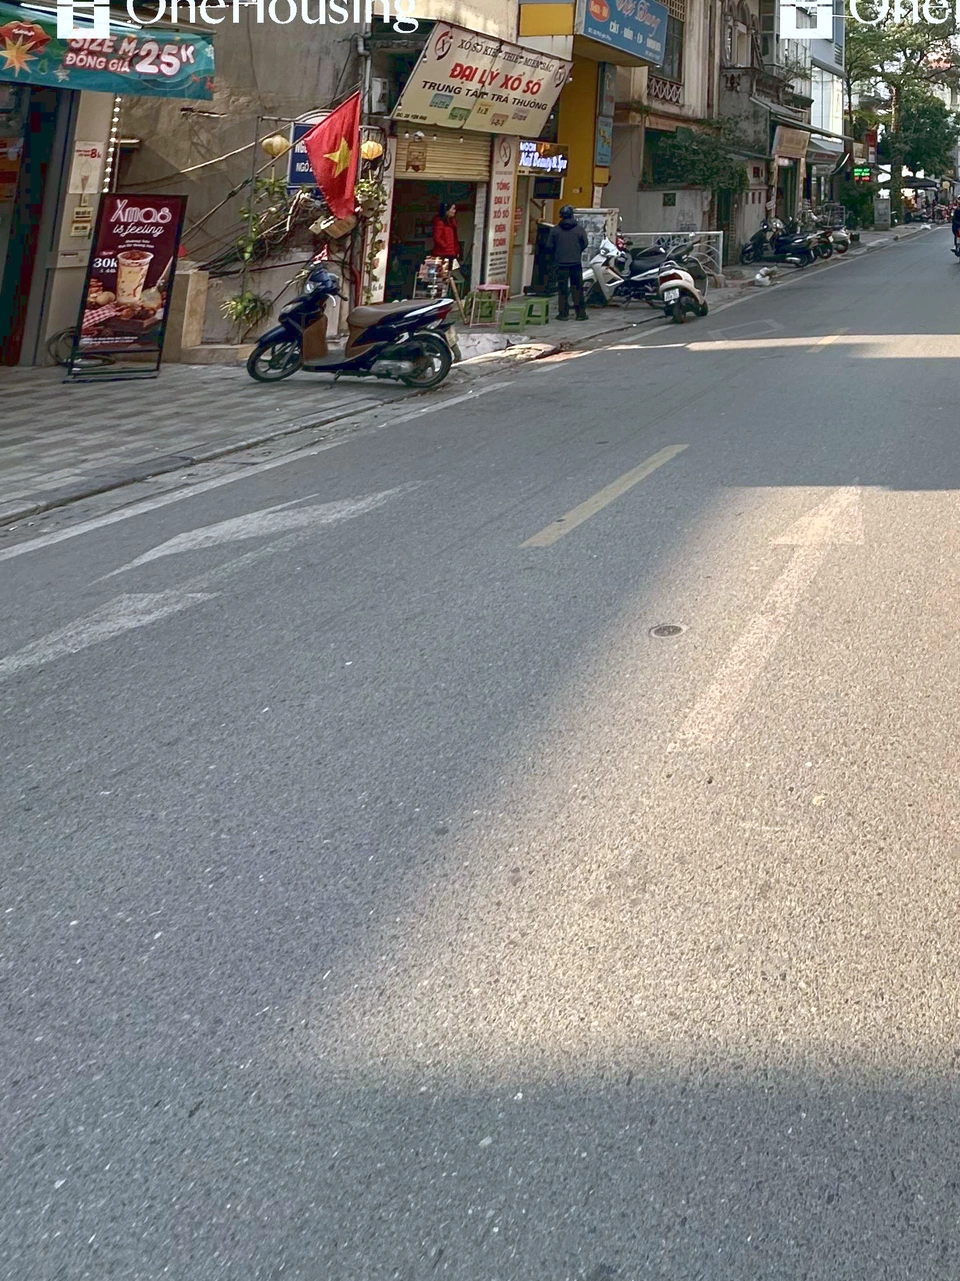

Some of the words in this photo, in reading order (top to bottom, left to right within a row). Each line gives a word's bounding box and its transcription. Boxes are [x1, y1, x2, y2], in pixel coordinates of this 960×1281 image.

[119, 36, 137, 56] M
[64, 49, 106, 68] ĐỒNG
[107, 53, 131, 72] GIÁ
[449, 62, 475, 85] ĐẠI
[478, 67, 500, 86] LÝ
[500, 71, 526, 92] XỔ
[523, 77, 545, 95] SỐ
[422, 80, 462, 95] TRUNG
[490, 91, 511, 104] TRẢ
[512, 97, 548, 111] THƯỞNG
[519, 151, 534, 167] Nail
[110, 199, 173, 224] Xmas
[113, 223, 123, 234] is
[120, 222, 164, 237] feeling
[93, 257, 118, 269] 30k
